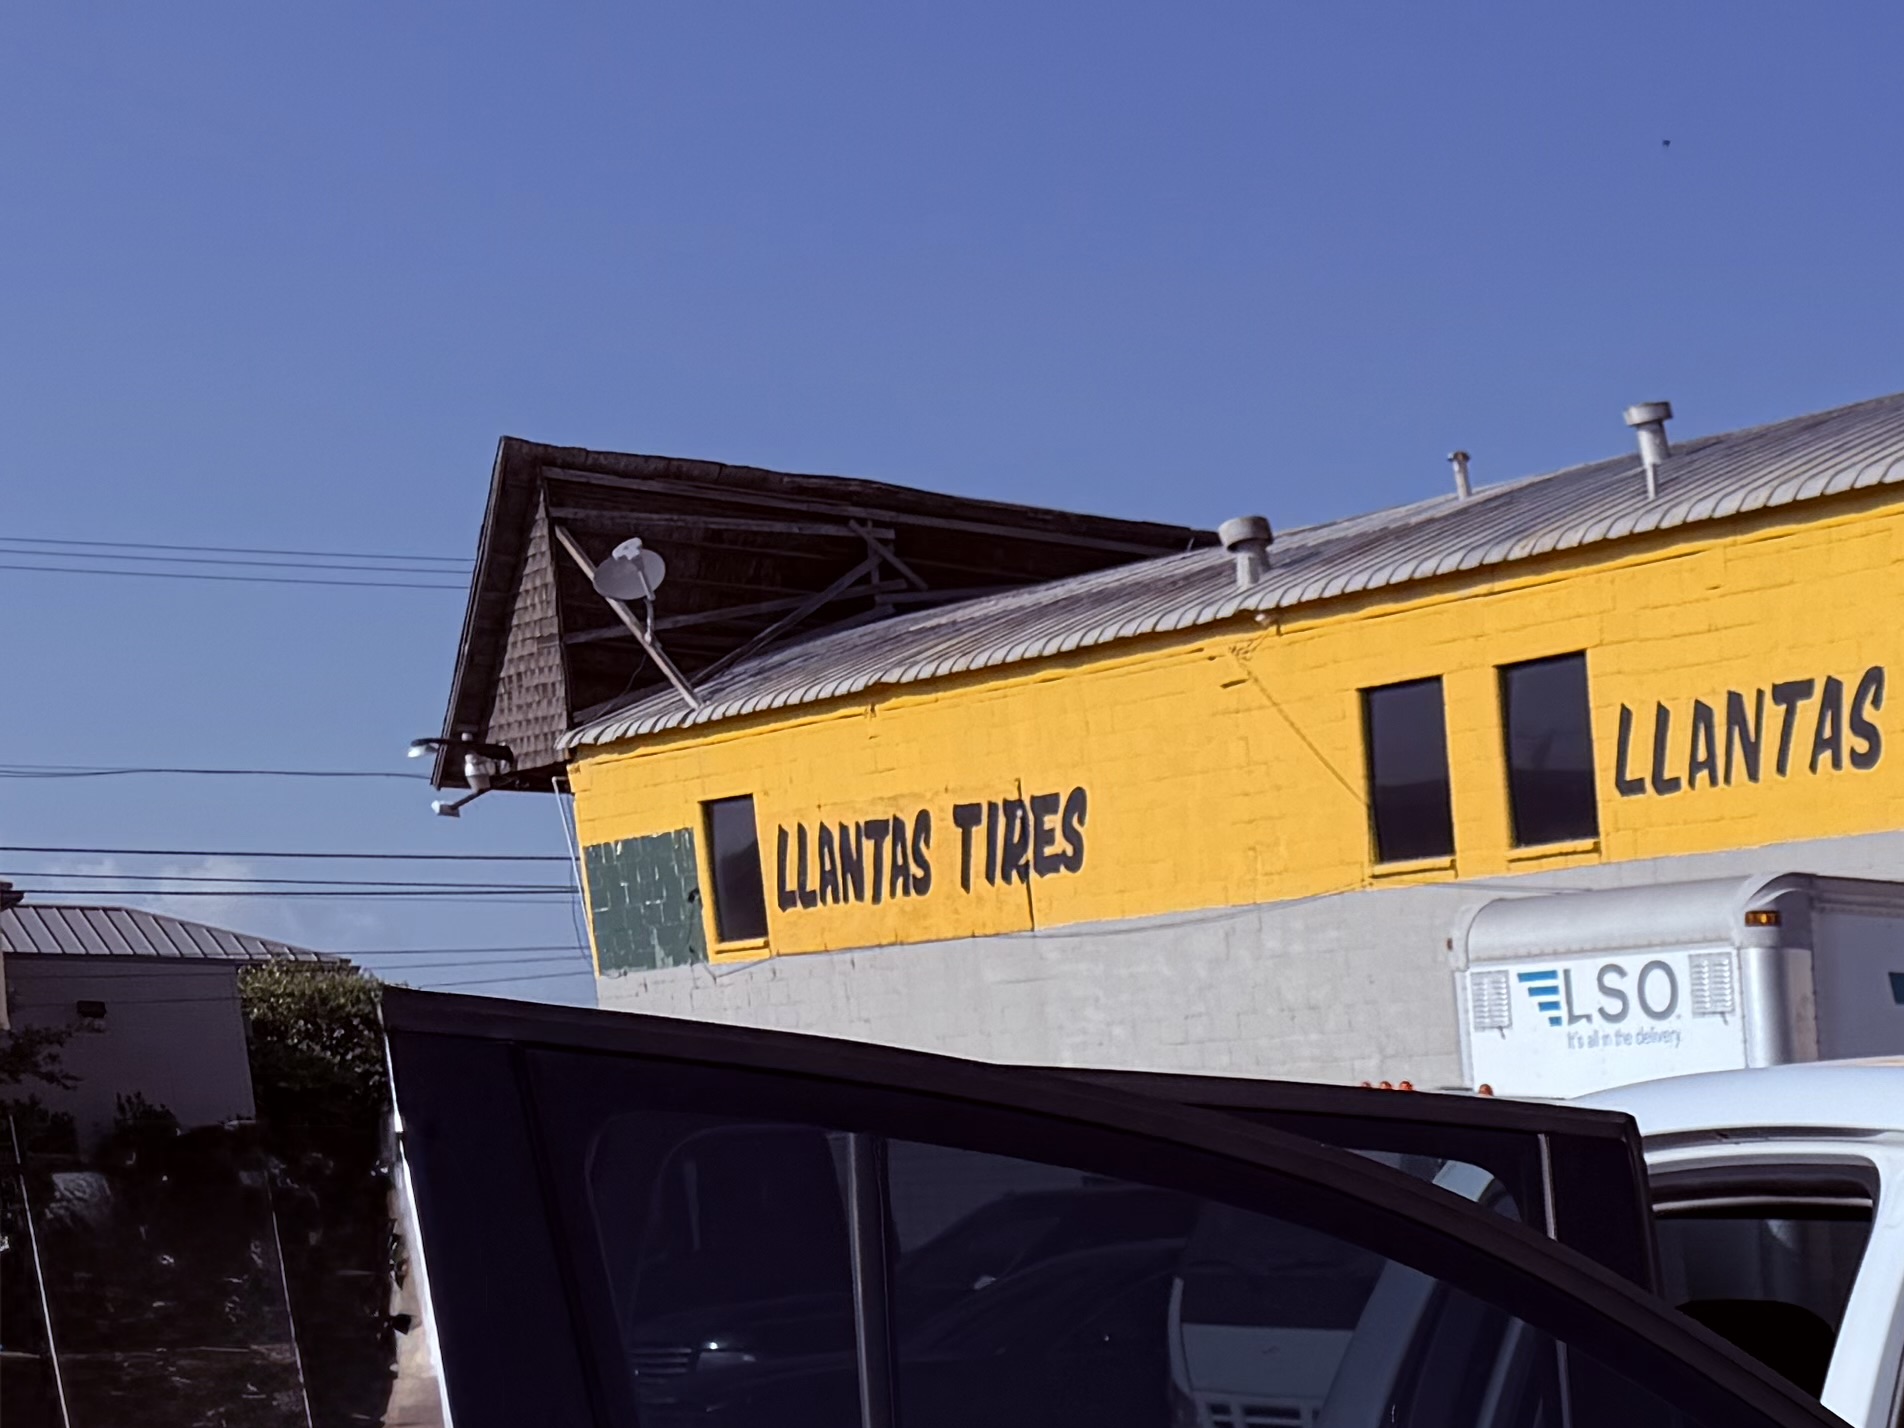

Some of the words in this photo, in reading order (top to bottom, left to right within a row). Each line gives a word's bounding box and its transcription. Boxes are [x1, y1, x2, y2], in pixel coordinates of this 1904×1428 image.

[1615, 665, 1886, 798] LLANTAS
[777, 809, 932, 912] LLANTAS
[953, 786, 1088, 893] TIRES
[1563, 960, 1679, 1025] LSO
[1567, 1030, 1584, 1050] It's
[1587, 1029, 1599, 1049] all
[1602, 1029, 1612, 1047] in
[1614, 1029, 1633, 1047] the
[1636, 1026, 1682, 1048] delivery
